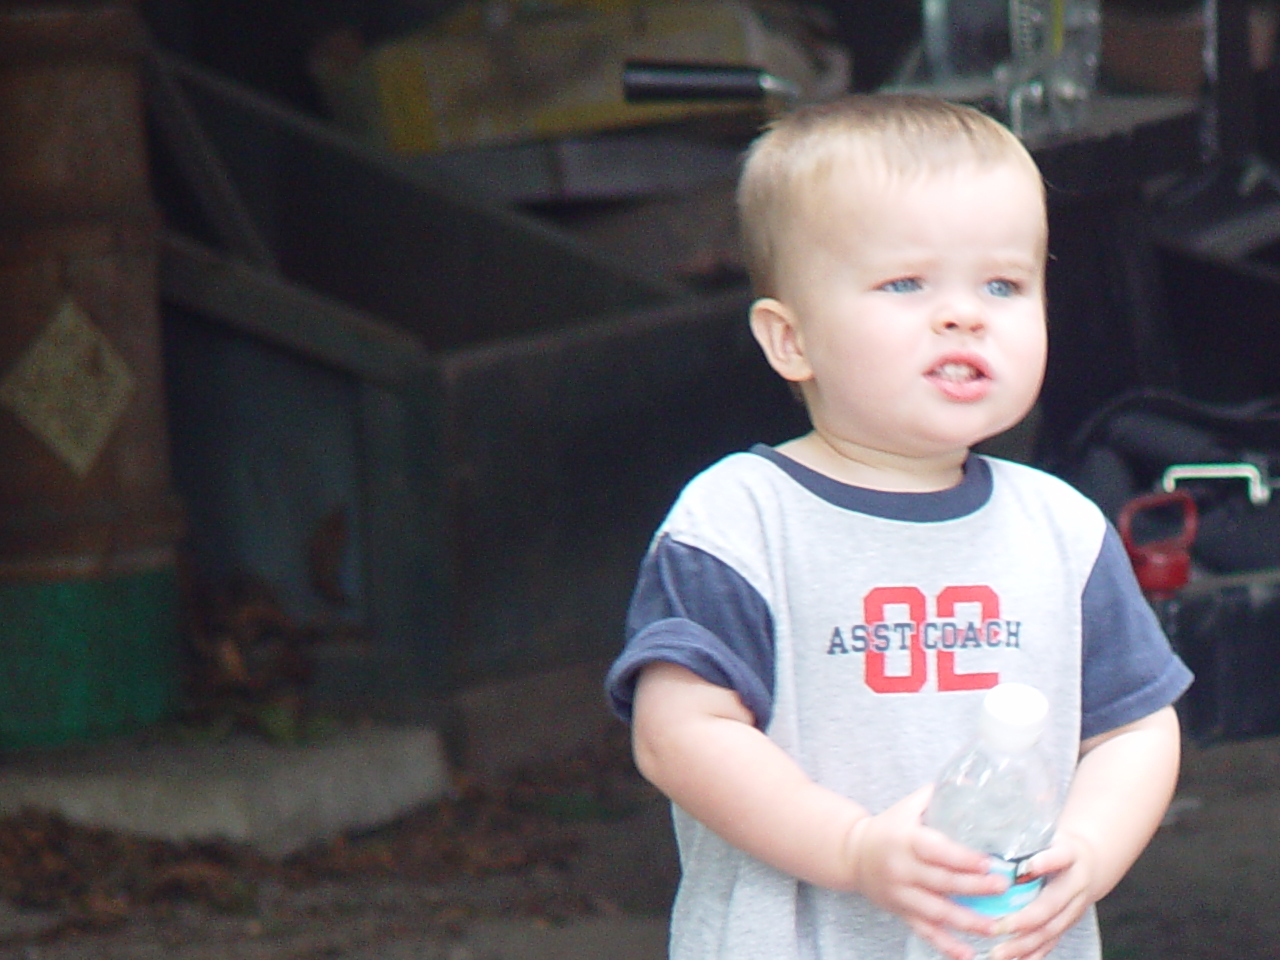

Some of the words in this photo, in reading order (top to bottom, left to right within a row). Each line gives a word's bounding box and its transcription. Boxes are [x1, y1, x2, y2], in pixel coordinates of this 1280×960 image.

[827, 622, 914, 655] ASST
[922, 620, 1022, 650] COACH
[864, 585, 1000, 693] 02
